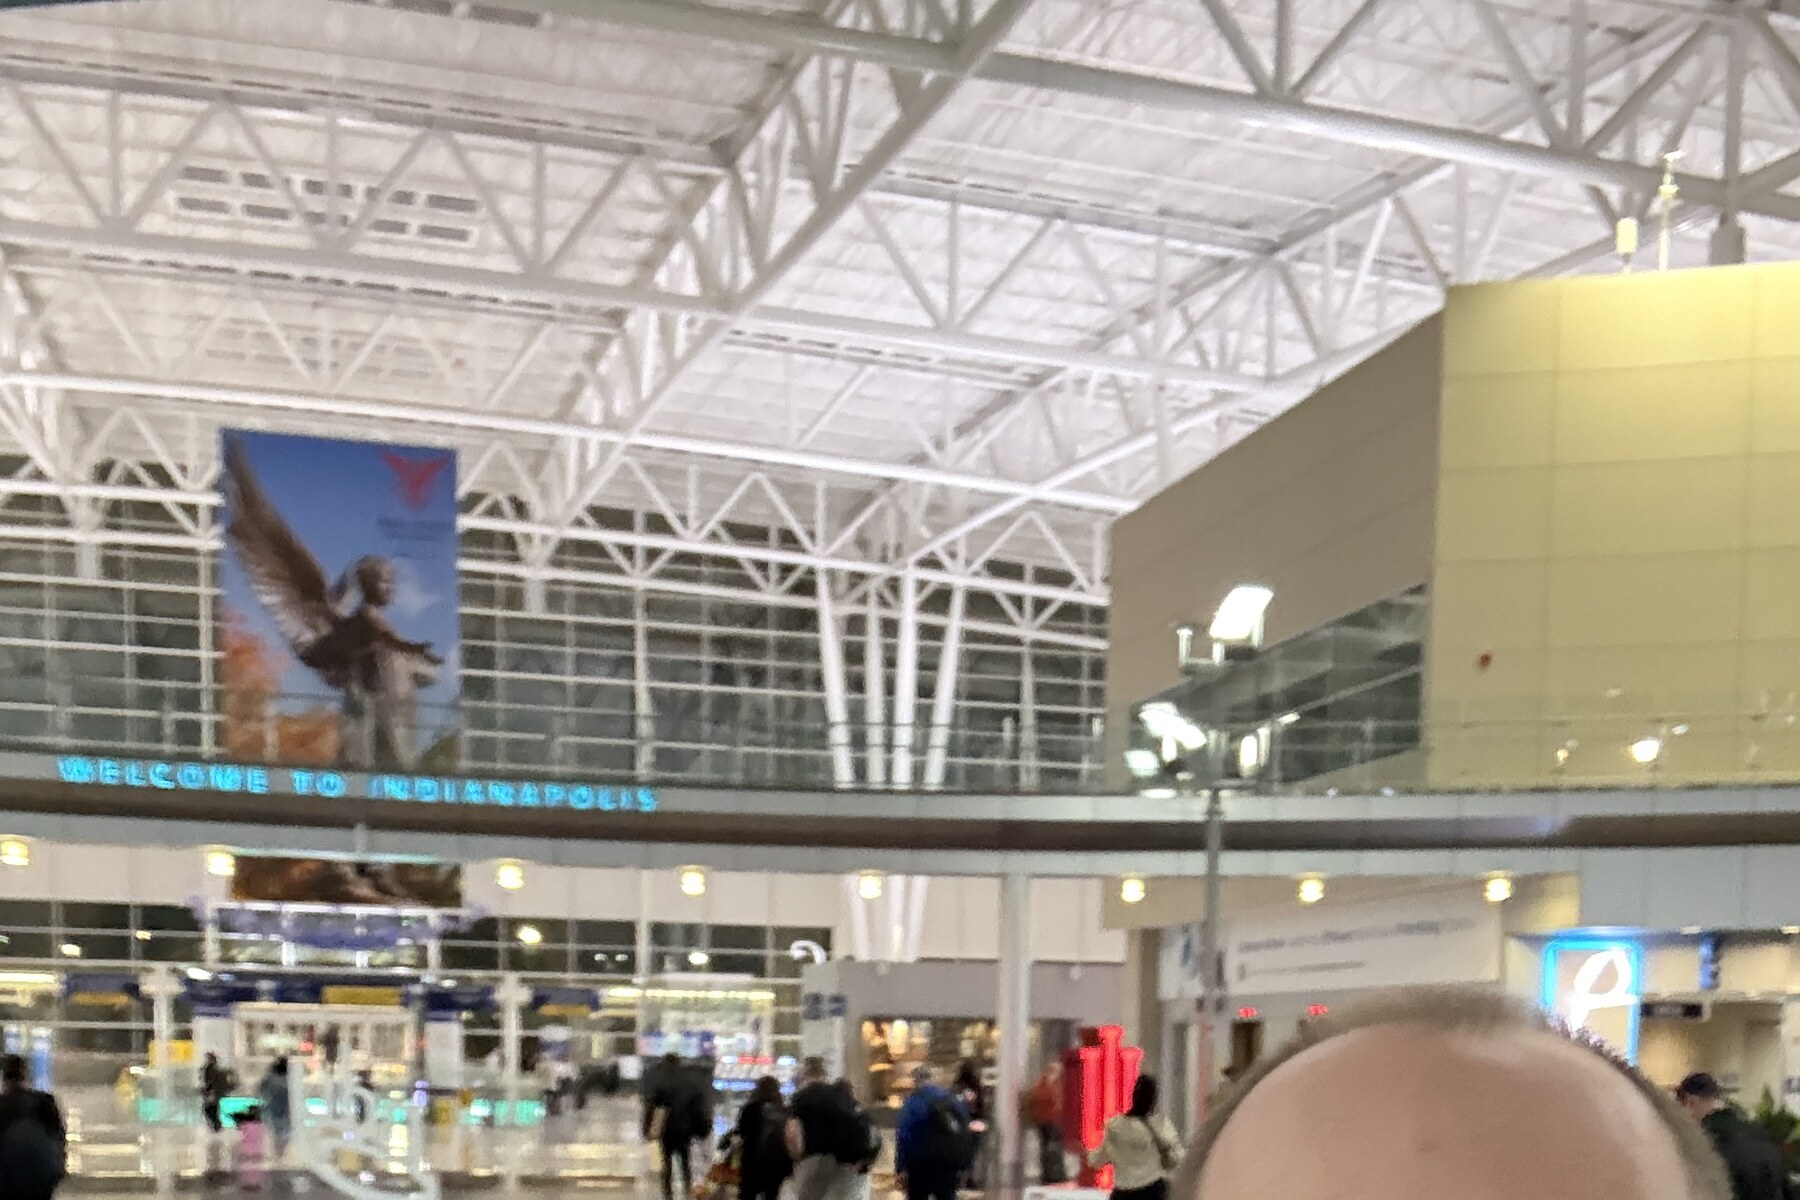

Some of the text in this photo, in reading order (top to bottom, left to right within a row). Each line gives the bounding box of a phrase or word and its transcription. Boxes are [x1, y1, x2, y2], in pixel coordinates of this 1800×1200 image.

[58, 757, 659, 813] WELCOME TO INDIANAPOLIS
